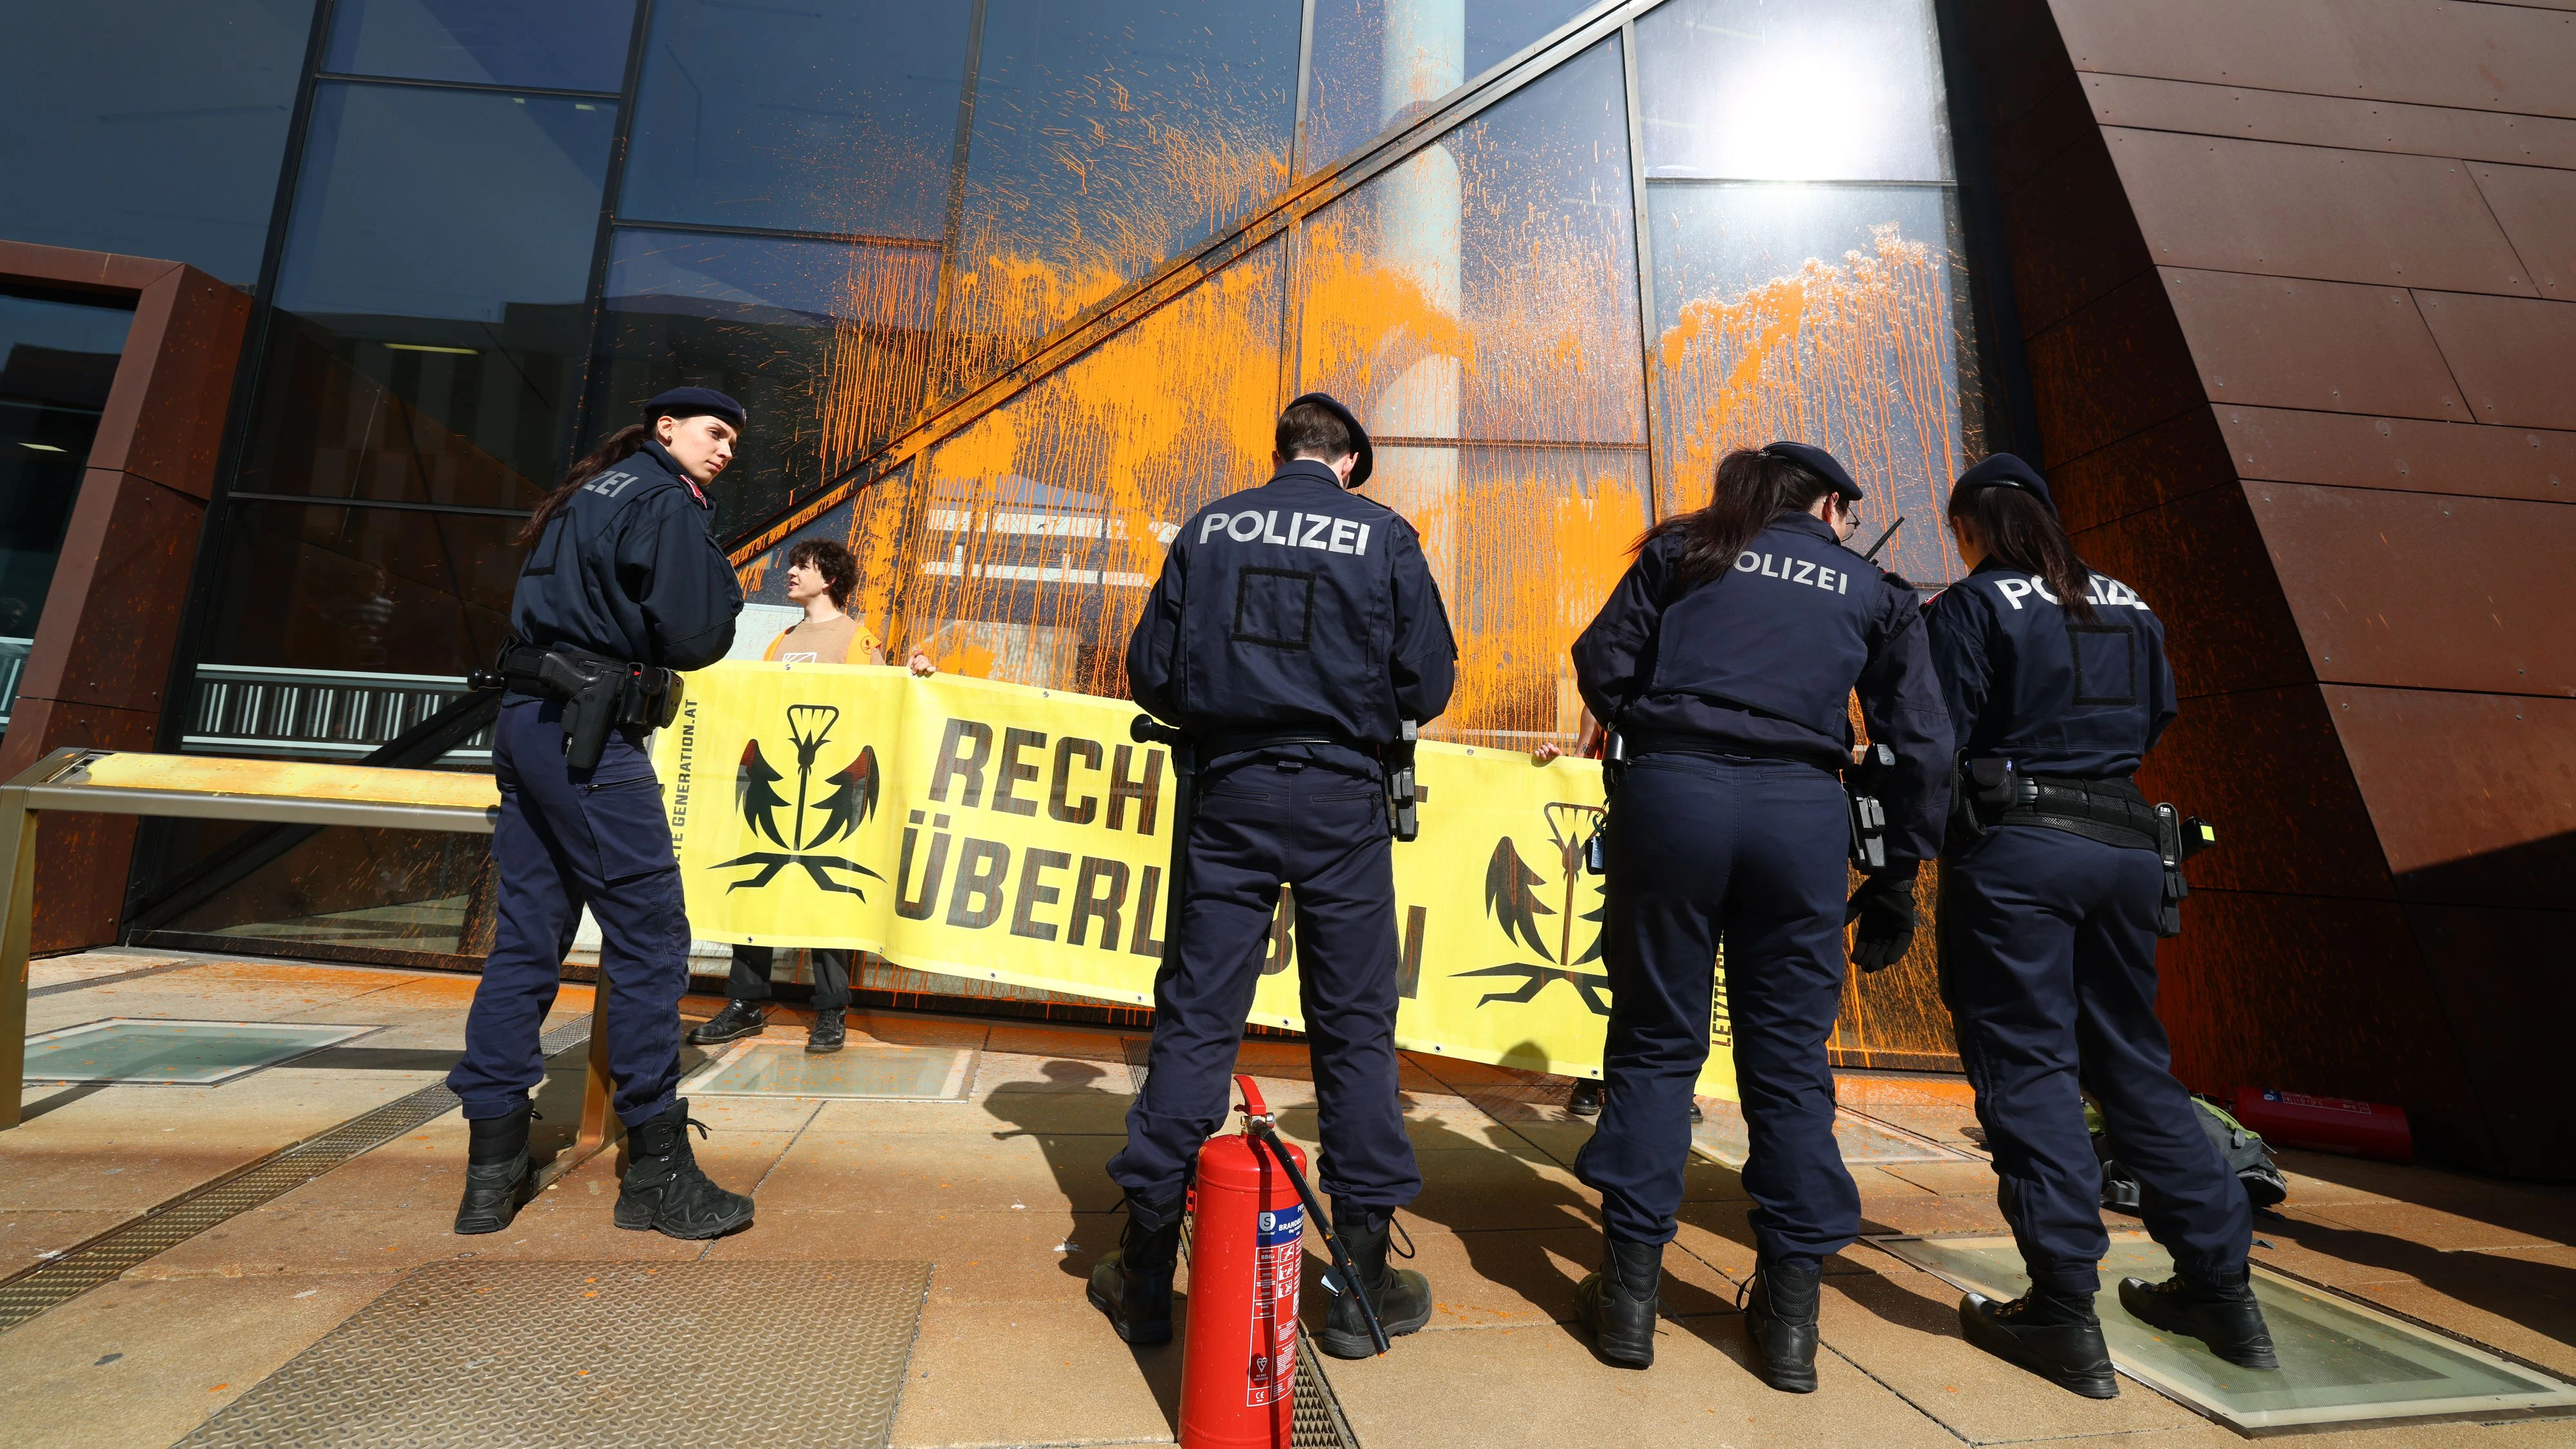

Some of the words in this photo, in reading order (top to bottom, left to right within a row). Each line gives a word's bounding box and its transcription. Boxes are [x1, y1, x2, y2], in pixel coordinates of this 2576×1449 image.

[1199, 510, 1370, 556] POLIZEI
[1734, 551, 1848, 595] OLIZEI
[672, 699, 697, 827] GENERATION.AT
[928, 717, 1165, 836] RECH
[1712, 976, 1732, 1047] LETZTE
